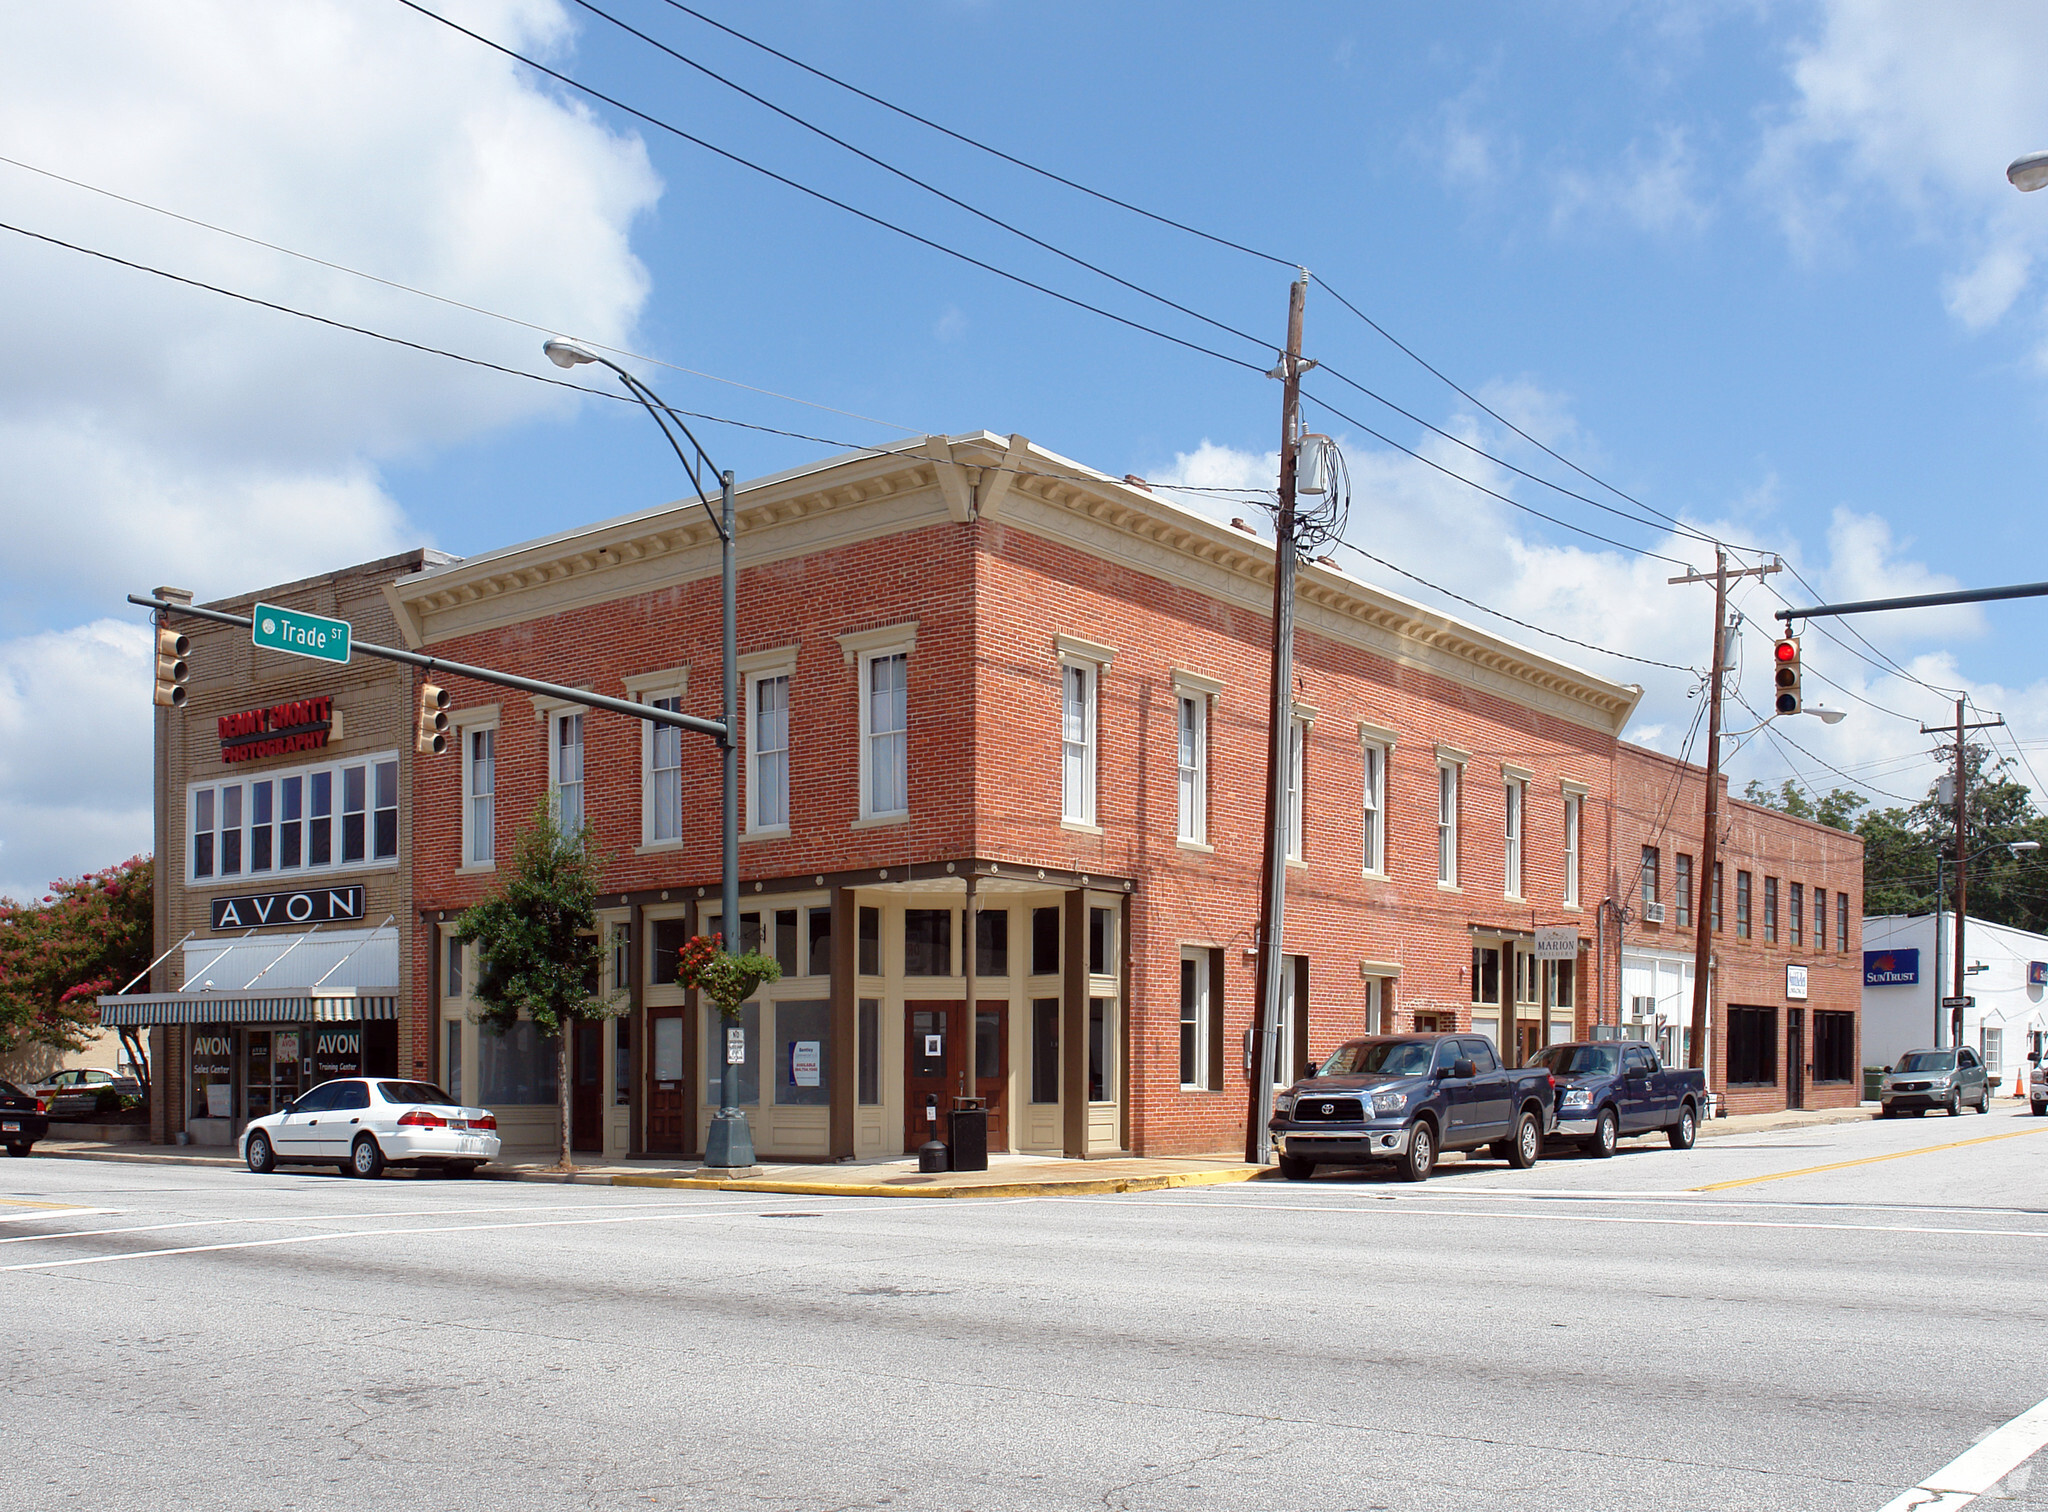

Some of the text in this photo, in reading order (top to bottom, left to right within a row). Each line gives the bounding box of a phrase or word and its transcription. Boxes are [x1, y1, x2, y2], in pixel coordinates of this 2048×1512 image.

[281, 619, 343, 648] Trade ST
[218, 695, 330, 739] DENNY SHORTT
[221, 731, 326, 764] PHOTOGRAPHY
[218, 889, 354, 927] AVON
[1537, 941, 1575, 951] MARION
[193, 1037, 231, 1056] AVON
[316, 1034, 360, 1054] AVON
[194, 1064, 230, 1074] Sales Center
[319, 1062, 357, 1073] Training Center
